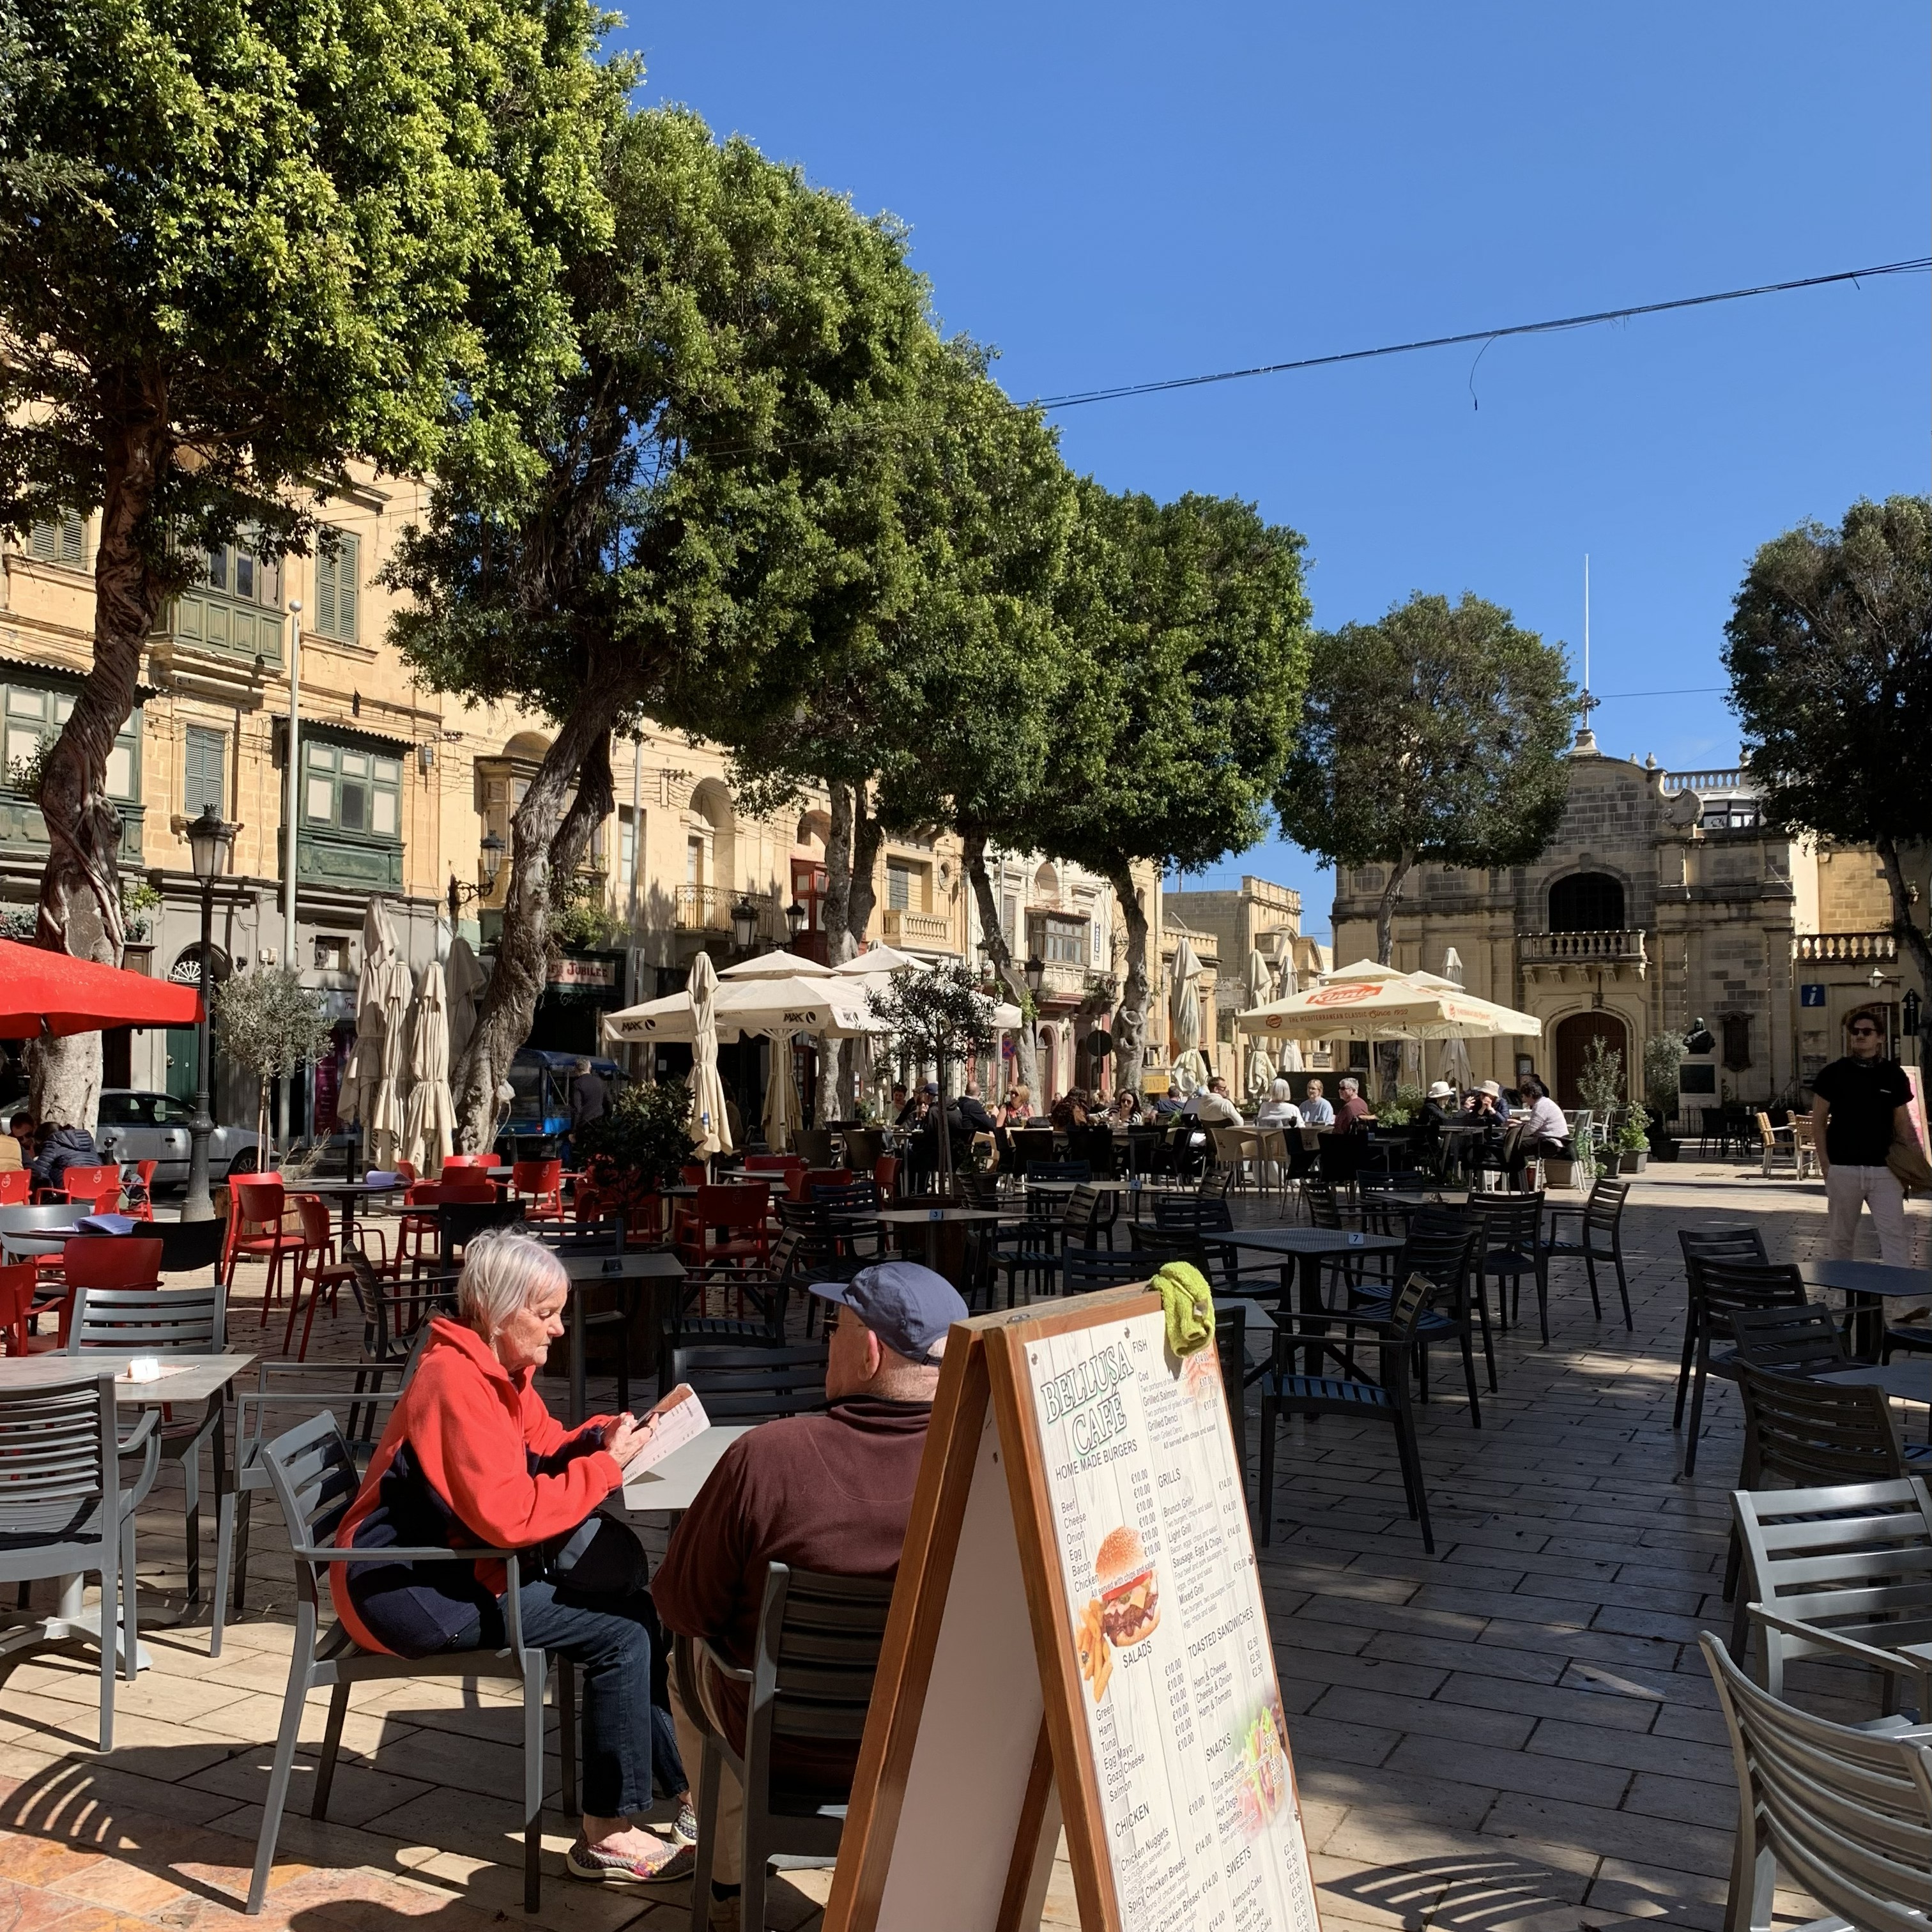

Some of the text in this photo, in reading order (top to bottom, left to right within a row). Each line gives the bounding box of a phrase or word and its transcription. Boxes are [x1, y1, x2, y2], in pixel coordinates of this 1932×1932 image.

[567, 962, 608, 977] JUBILEE
[1300, 1013, 1344, 1022] MEDITERRANEAN
[1369, 1009, 1391, 1019] Since
[1310, 988, 1378, 1003] Kinnie
[1353, 1234, 1359, 1243] 7
[1132, 1339, 1147, 1353] FISH
[1040, 1342, 1135, 1423] BELLUSA
[1138, 1370, 1149, 1381] Cod
[1143, 1375, 1213, 1406] Grilled Salmon €17.00
[1071, 1385, 1128, 1456] CAFÉ
[1147, 1398, 1217, 1431] Grilled Denci €17.00
[1169, 1436, 1181, 1447] served
[1190, 1430, 1199, 1439] chips
[1206, 1423, 1216, 1432] salad
[1055, 1439, 1137, 1480] HOME MADE BURGERS
[1158, 1468, 1181, 1487] GRILLS
[1061, 1469, 1147, 1513] Beef €10.00
[1064, 1483, 1150, 1529] Cheese €10.00
[1163, 1476, 1232, 1517] Brunch Grill €14.00
[1066, 1498, 1153, 1544] Onion €10.00
[1069, 1512, 1155, 1561] Egg €10.00
[1168, 1500, 1236, 1544] Light Grill €14.00
[1195, 1544, 1204, 1557] Egg
[1205, 1541, 1209, 1551] &
[1209, 1535, 1222, 1548] Chips
[1227, 1523, 1241, 1538] €14.00
[1071, 1526, 1158, 1576] Bacon €10.00
[1075, 1541, 1161, 1592] Chicken €10.00
[1098, 1581, 1114, 1594] served
[1114, 1576, 1123, 1586] with
[1124, 1570, 1135, 1581] chips
[1136, 1565, 1144, 1575] and
[1144, 1559, 1156, 1570] salad
[1179, 1558, 1246, 1605] Mixed Grill €15.00
[1188, 1607, 1254, 1658] TOASTED SANDWICHES
[1123, 1641, 1151, 1668] SALADS
[1193, 1636, 1258, 1689] Ham & Cheese €2.50
[1096, 1658, 1181, 1721] Green €10.00
[1196, 1650, 1261, 1703] Cheese & Onion €2.50
[1199, 1662, 1262, 1718] Ham & Tomato €2.50
[1098, 1673, 1183, 1736] Ham €10.00
[1101, 1687, 1186, 1753] Tuna €10.00
[1104, 1703, 1189, 1770] Egg Mayo €10.00
[1107, 1717, 1192, 1785] Gozo Cheese €10.00
[1206, 1733, 1231, 1761] SNACKS
[1109, 1731, 1194, 1802] Salmon €10.00
[1211, 1777, 1223, 1791] Tuna
[1223, 1760, 1244, 1782] Baguette
[1116, 1802, 1149, 1837] CHICKEN
[1216, 1804, 1225, 1818] Hot
[1225, 1795, 1238, 1811] Dogs
[1219, 1809, 1242, 1835] Baguettes
[1121, 1795, 1205, 1871] Chicken Nuggets €10.00
[1128, 1833, 1211, 1914] Spicy Chicken Breast €14.00
[1131, 1860, 1148, 1879] nuggets
[1149, 1847, 1162, 1864] served
[1146, 1866, 1158, 1880] salad
[1227, 1846, 1251, 1878] SWEETS
[1232, 1838, 1294, 1910] Almond Cake €2.00
[1130, 1912, 1140, 1927] Two
[1139, 1900, 1156, 1919] portions
[1162, 1882, 1177, 1899] chicken
[1177, 1869, 1190, 1885] breast
[1160, 1908, 1182, 1932] Chicken
[1183, 1890, 1200, 1912] Breast
[1202, 1871, 1218, 1893] €14.00
[1168, 1896, 1176, 1908] and
[1176, 1885, 1187, 1900] salad
[1236, 1852, 1297, 1925] Apple Pie €2.50
[1184, 1909, 1197, 1925] breast
[1209, 1910, 1225, 1932] €14.00
[1252, 1907, 1264, 1924] Cake
[1261, 1917, 1271, 1932] Cake
